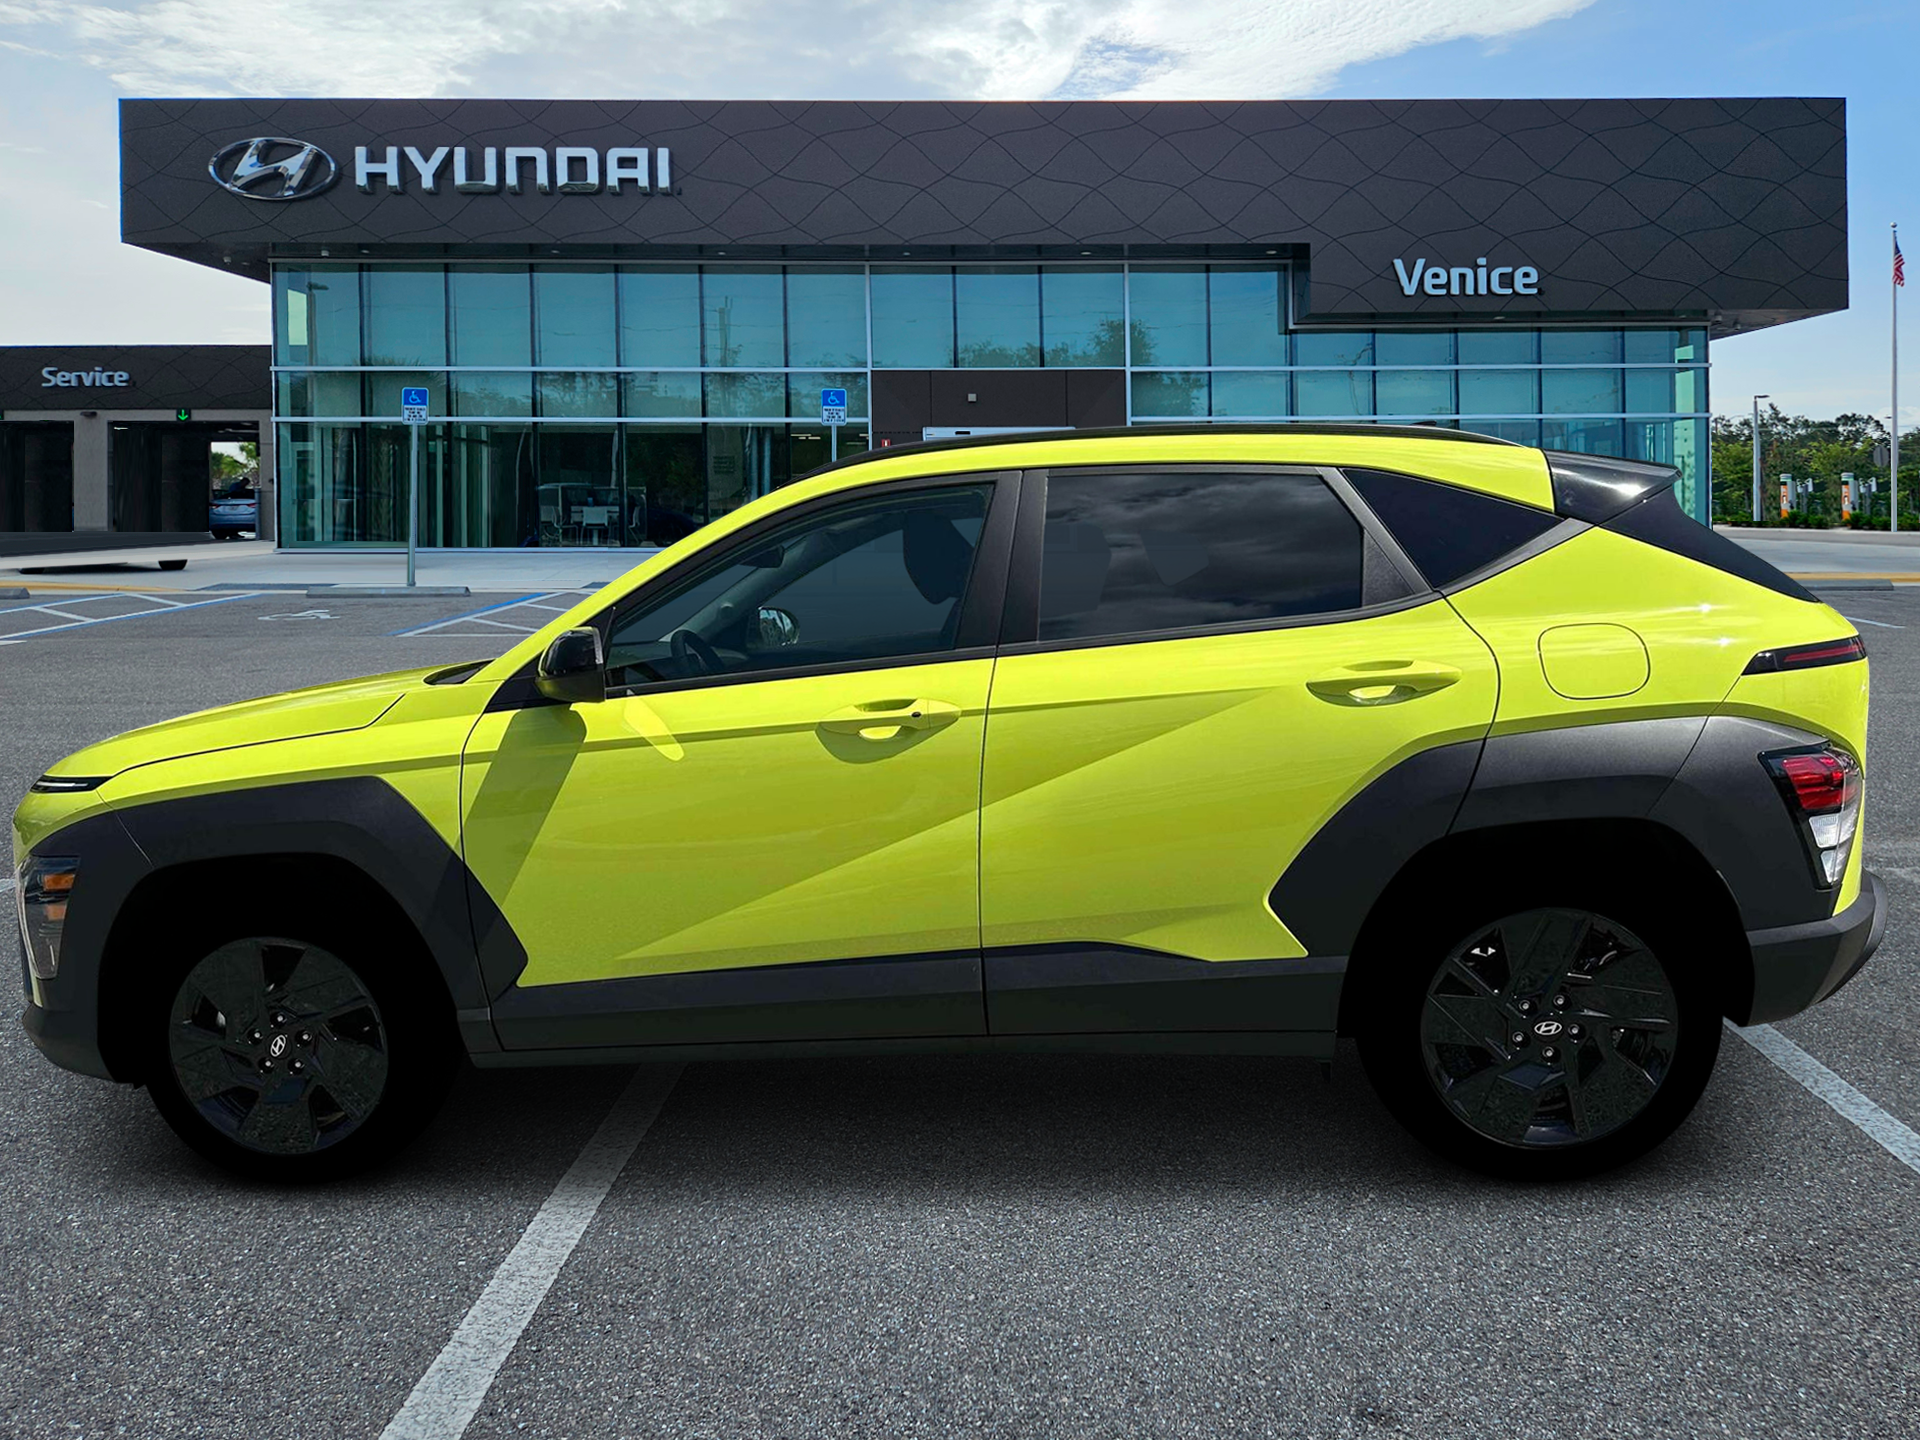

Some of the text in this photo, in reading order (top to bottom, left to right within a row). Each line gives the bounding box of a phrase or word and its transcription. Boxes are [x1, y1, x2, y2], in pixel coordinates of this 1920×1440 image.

[355, 146, 670, 194] HYUNDAI
[1393, 257, 1539, 296] Venice
[41, 366, 130, 387] Service
